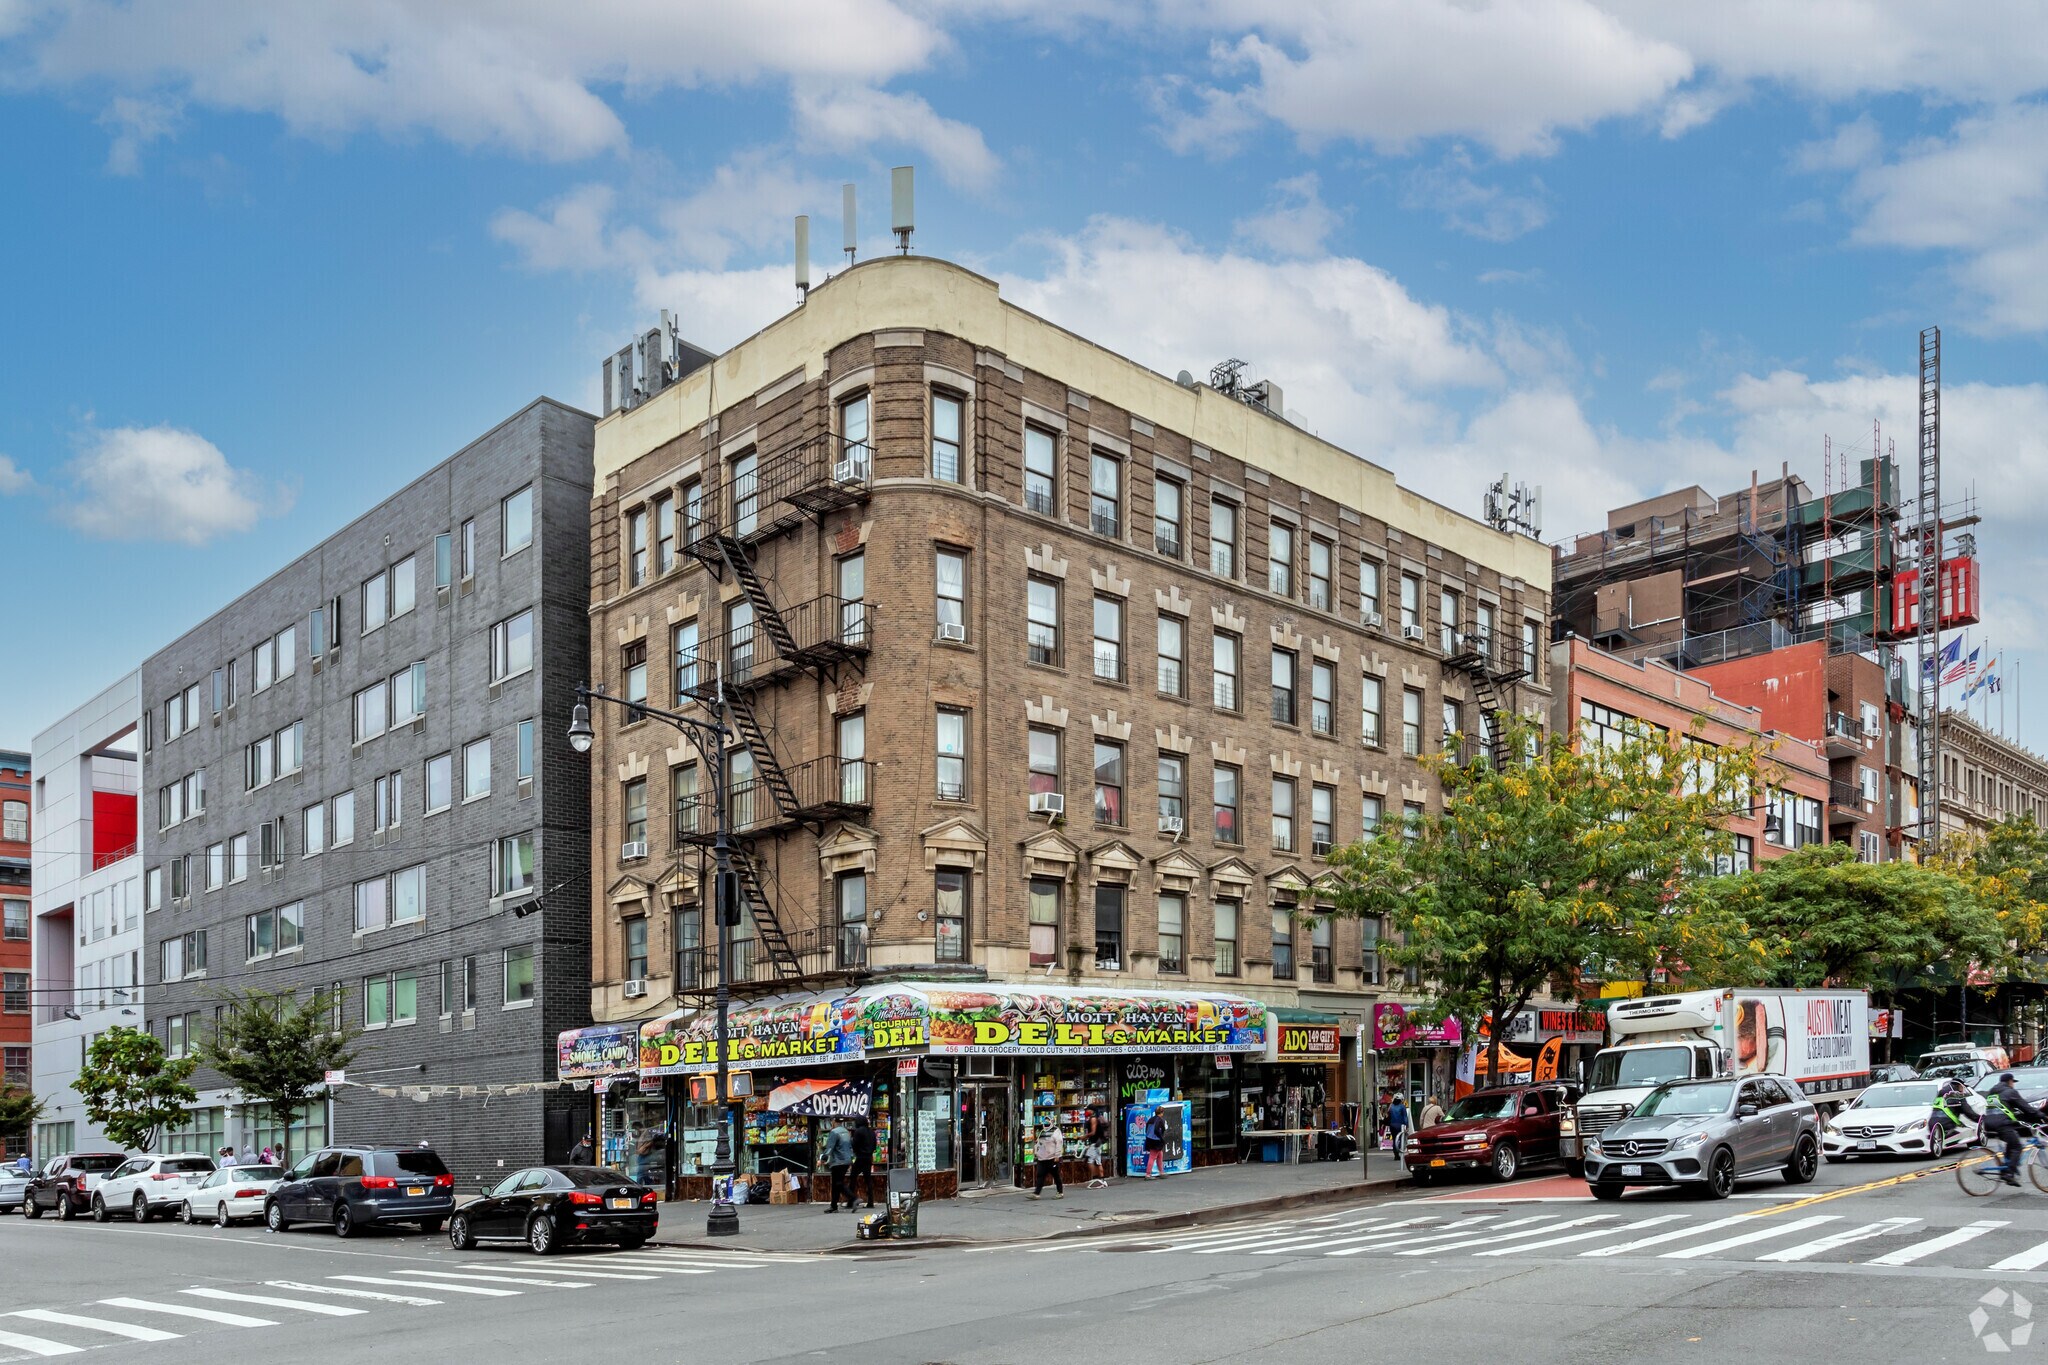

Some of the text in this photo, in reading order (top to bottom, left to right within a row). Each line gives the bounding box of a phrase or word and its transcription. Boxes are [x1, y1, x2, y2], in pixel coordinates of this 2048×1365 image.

[873, 1019, 922, 1029] GOURMET
[1066, 1012, 1184, 1023] MOTT HAVEN
[1543, 1011, 1566, 1030] WINES
[1568, 1011, 1573, 1030] &
[754, 1021, 799, 1035] HAVEN
[974, 1022, 1105, 1045] DELI
[1113, 1030, 1128, 1044] &
[1137, 1030, 1230, 1043] MARKET
[576, 1039, 601, 1051] Dollar
[874, 1026, 924, 1048] DELI
[1284, 1030, 1308, 1051] ADO
[1320, 1030, 1335, 1043] GIFT
[570, 1051, 597, 1064] SMOKE
[602, 1045, 628, 1060] CANDY
[744, 1044, 755, 1059] &
[761, 1037, 839, 1057] MARKET
[1308, 1043, 1334, 1051] VARIETY SHOP
[1807, 1036, 1852, 1059] & SEAFOOD COMPANY
[668, 1065, 687, 1073] GROCERY
[690, 1064, 701, 1072] COLD
[701, 1063, 712, 1071] CUTS
[727, 1061, 752, 1069] ANDWICHES
[767, 1059, 797, 1067] SANDWICHES
[898, 1060, 917, 1069] ATM
[641, 1076, 661, 1084] ATM
[813, 1094, 868, 1116] OPENING
